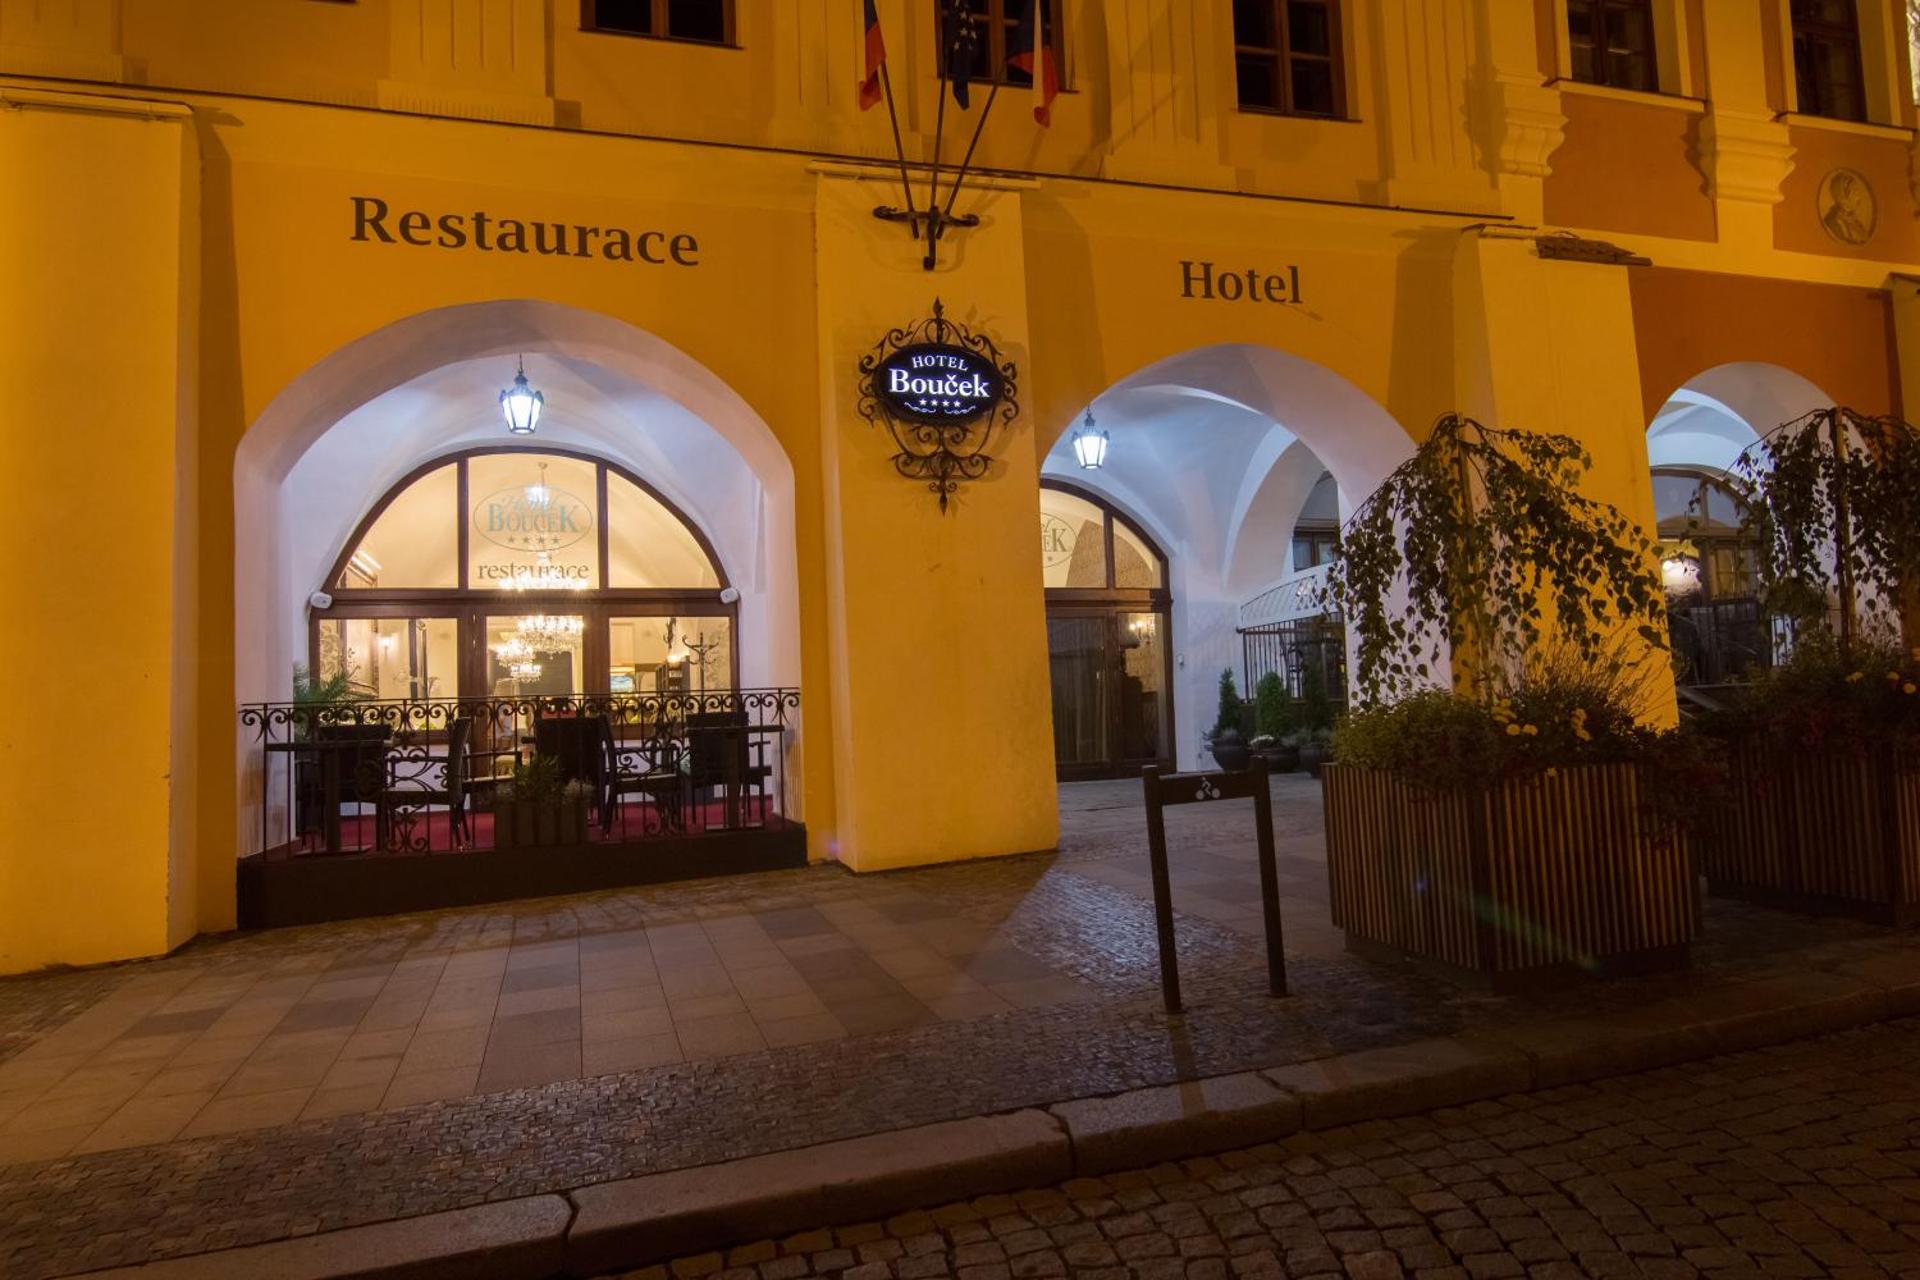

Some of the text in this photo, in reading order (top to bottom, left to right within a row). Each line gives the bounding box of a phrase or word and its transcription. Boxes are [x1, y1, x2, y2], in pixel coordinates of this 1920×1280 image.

[350, 197, 699, 266] Restaurace
[1179, 261, 1303, 304] Hotel
[912, 355, 968, 371] HOTEL
[889, 368, 990, 398] Bouček
[478, 561, 590, 580] restaurace
